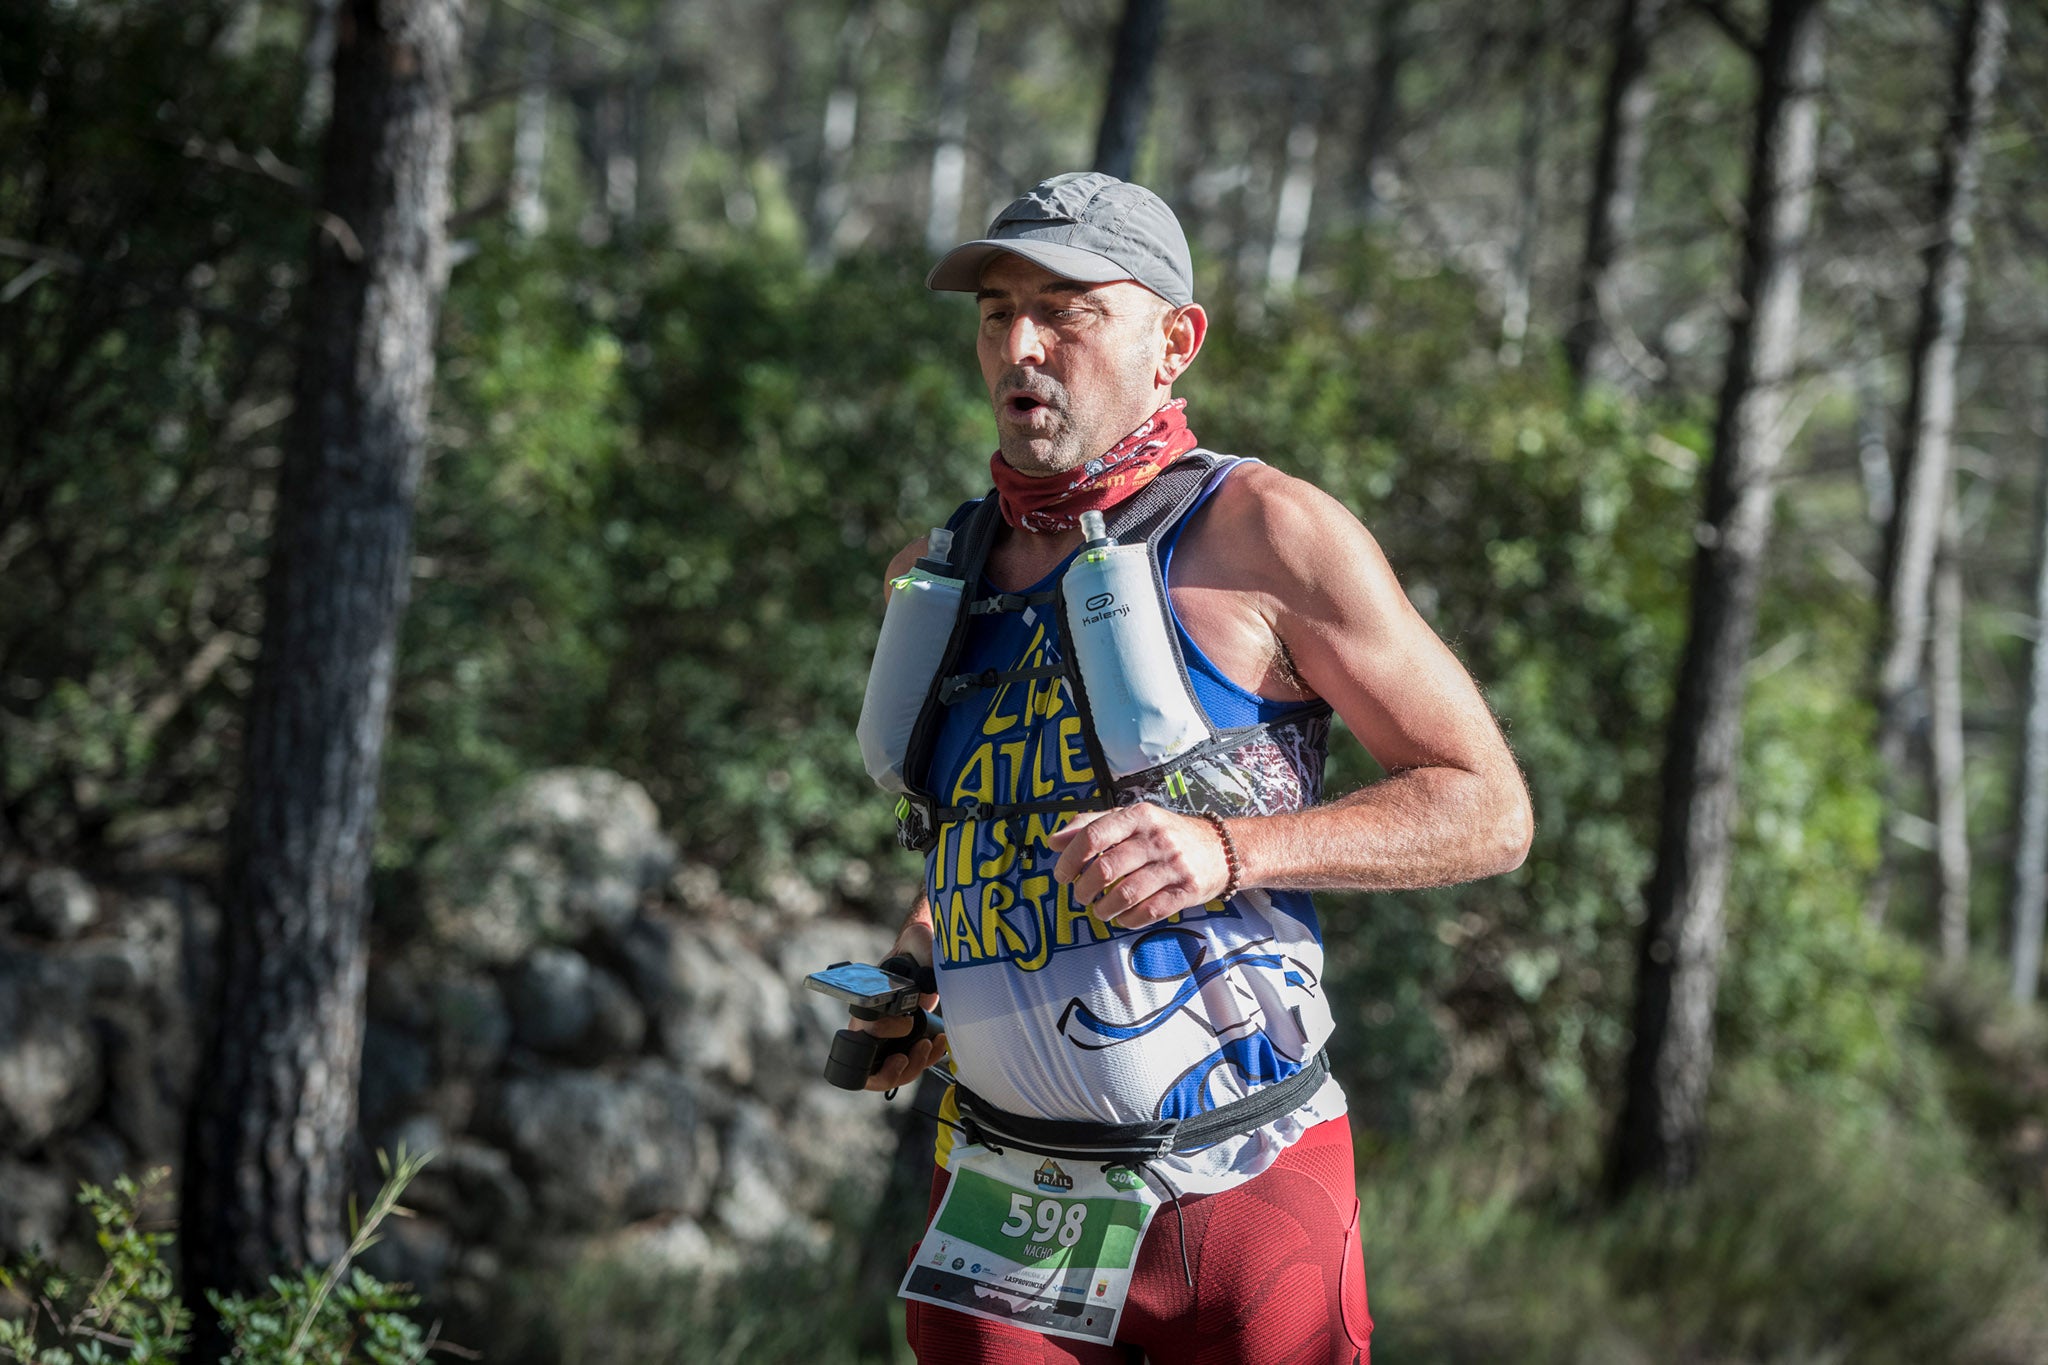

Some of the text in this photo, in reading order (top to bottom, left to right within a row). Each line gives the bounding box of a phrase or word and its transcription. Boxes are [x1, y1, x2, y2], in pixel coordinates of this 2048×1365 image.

[1082, 604, 1131, 627] Kalenji
[1036, 1172, 1071, 1187] TRAIL
[1112, 1172, 1137, 1187] 30K
[1000, 1192, 1088, 1248] 598
[1023, 1243, 1053, 1261] NACHO
